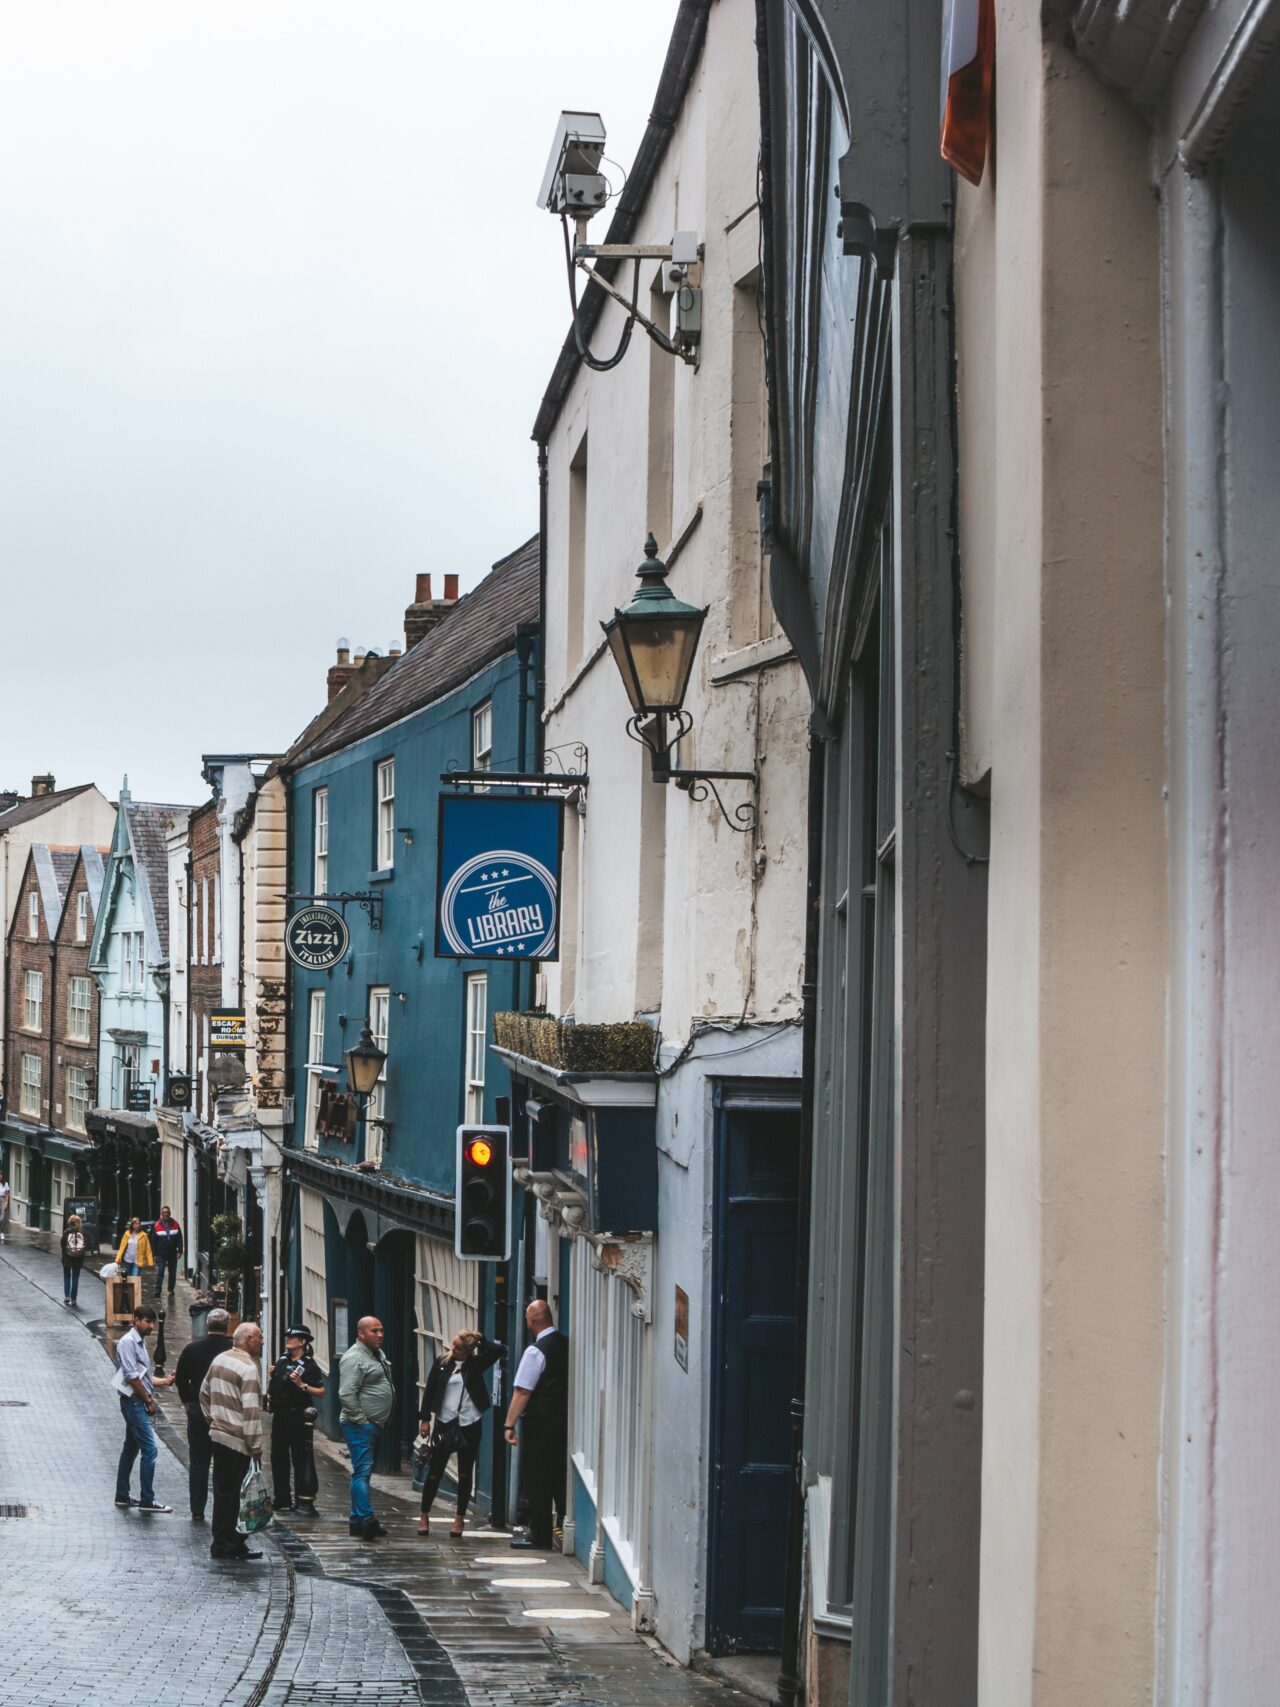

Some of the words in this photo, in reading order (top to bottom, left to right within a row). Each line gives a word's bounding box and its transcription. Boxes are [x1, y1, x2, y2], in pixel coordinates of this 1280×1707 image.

[488, 890, 507, 910] the
[299, 912, 336, 926] INDIVIDUALLY
[467, 904, 544, 943] LIBRARY
[294, 929, 339, 946] Zizzi
[298, 950, 335, 964] ITALIAN
